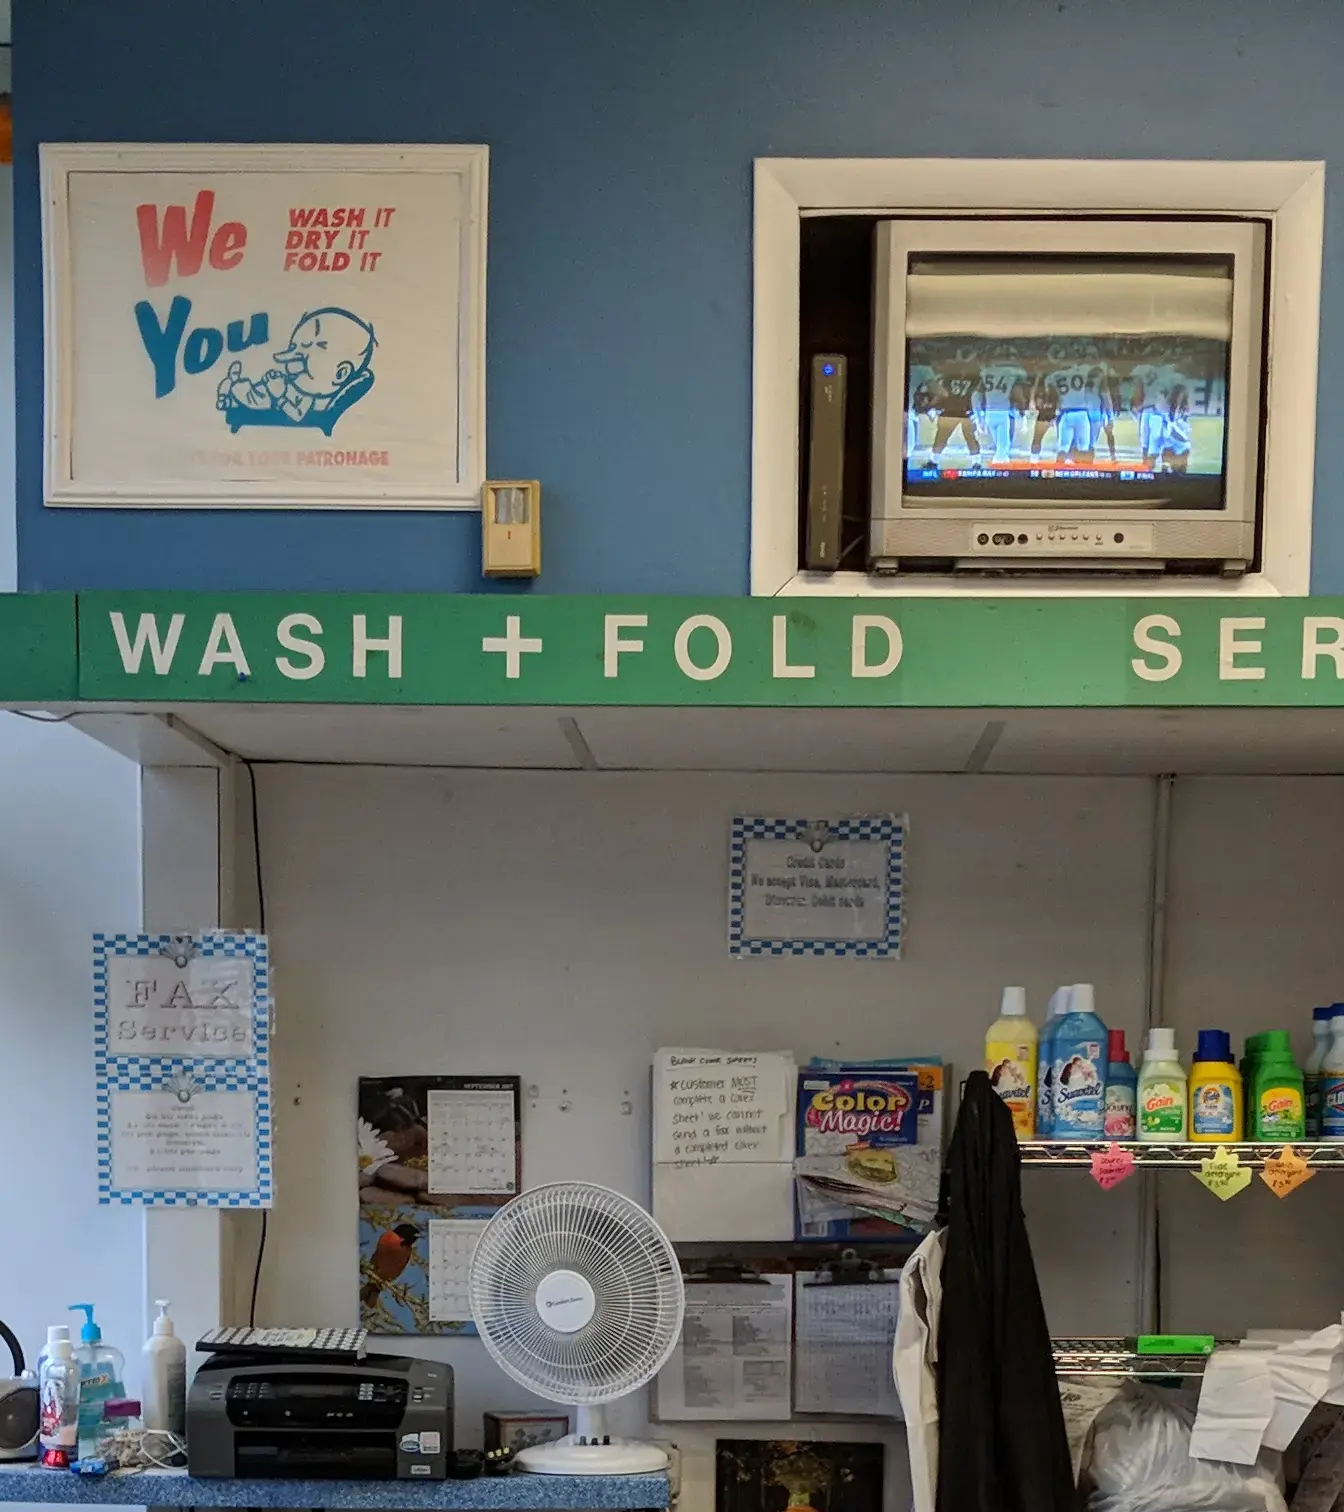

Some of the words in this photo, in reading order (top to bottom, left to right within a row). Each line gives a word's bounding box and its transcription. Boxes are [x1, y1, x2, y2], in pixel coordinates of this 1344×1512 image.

[288, 208, 364, 228] WASH
[373, 208, 396, 228] IT
[136, 190, 247, 288] We
[285, 230, 340, 250] DRY
[347, 230, 370, 250] IT
[283, 252, 352, 272] FOLD
[359, 252, 382, 272] IT
[134, 296, 269, 399] You
[296, 451, 390, 467] PATRONAGE
[109, 612, 404, 680] WASH
[604, 615, 904, 681] FOLD
[126, 980, 240, 1010] FAX
[118, 1021, 247, 1042] Service
[812, 1092, 907, 1112] Color
[1057, 1082, 1104, 1103] Suavitel
[1144, 1096, 1175, 1111] Gain
[1266, 1097, 1294, 1112] Gain
[820, 1110, 904, 1134] Magic!
